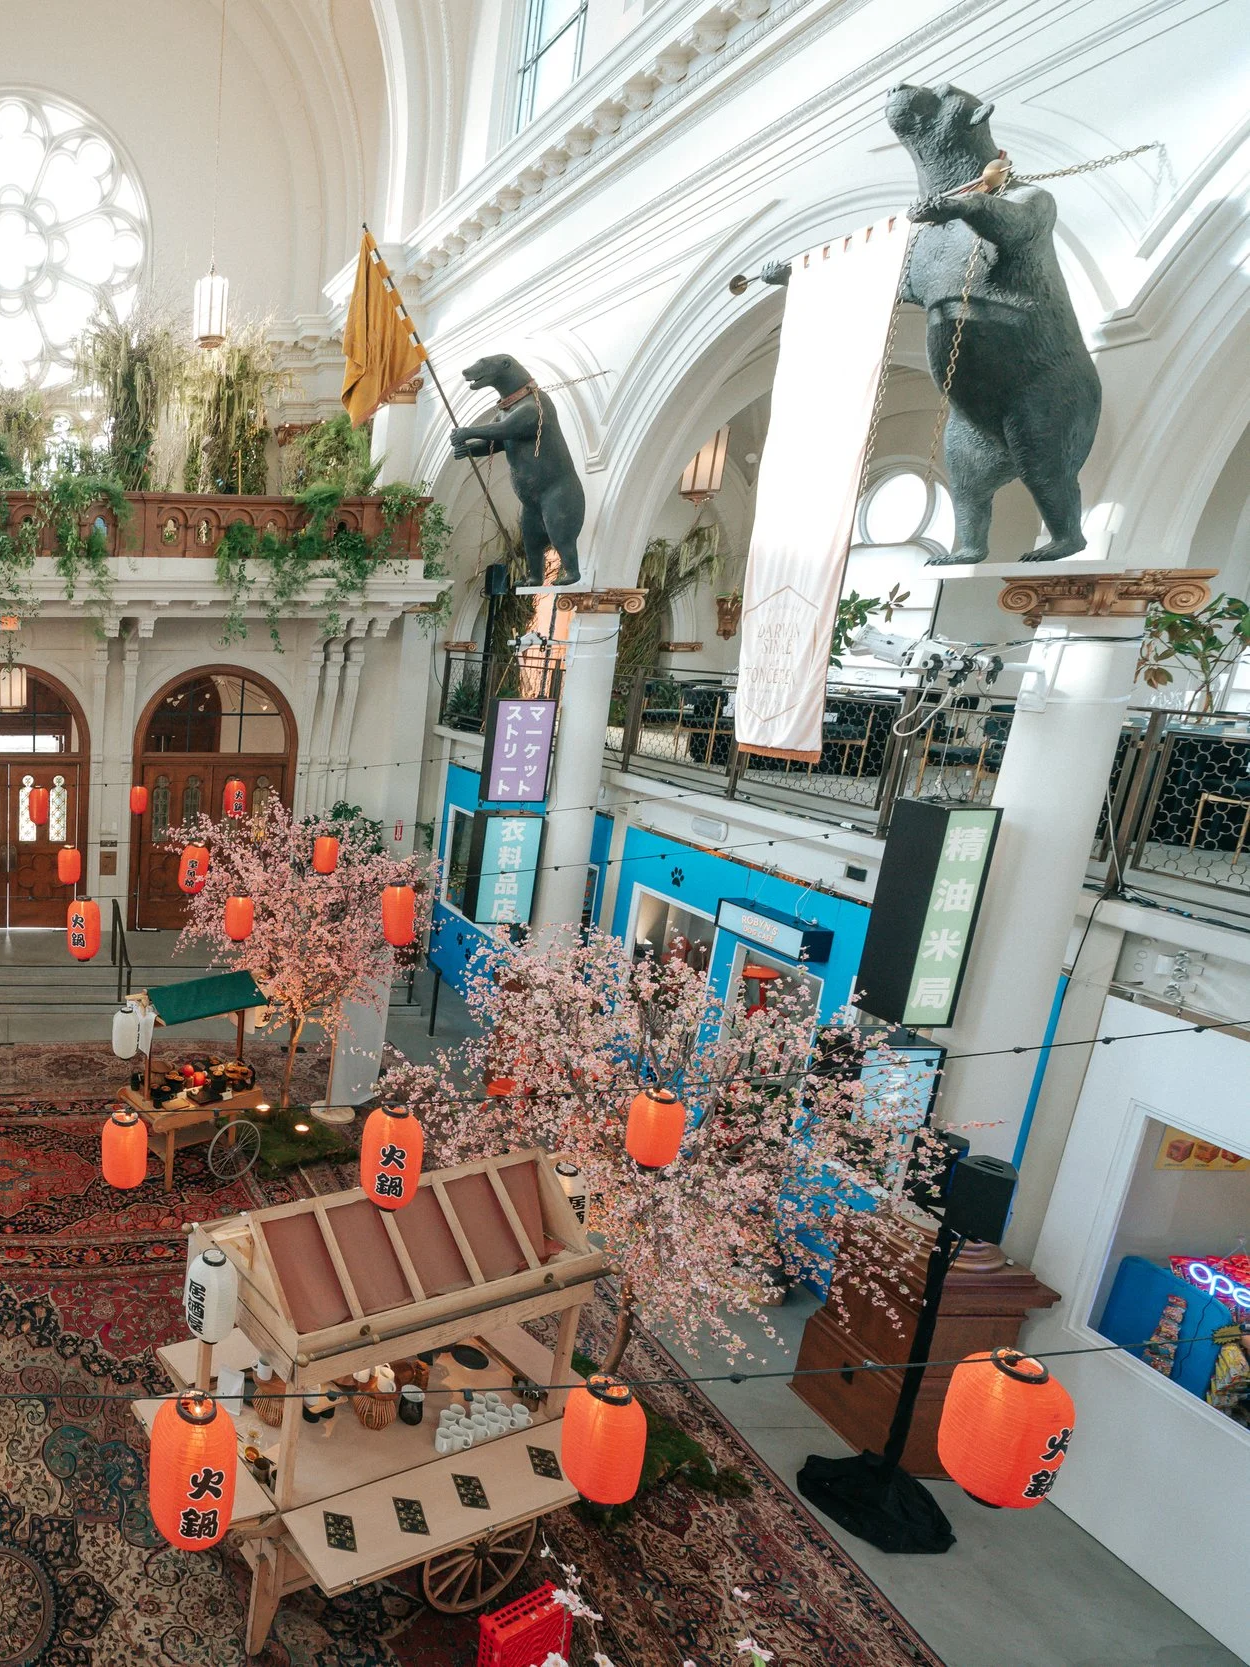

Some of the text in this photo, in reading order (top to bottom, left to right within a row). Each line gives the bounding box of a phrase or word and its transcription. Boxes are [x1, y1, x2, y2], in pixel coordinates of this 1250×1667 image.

[497, 706, 522, 796] ストリート
[517, 706, 546, 796] マーケット
[489, 820, 526, 922] 衣料品店
[71, 913, 86, 948] 火鍋
[741, 914, 780, 936] ROBYN'S
[910, 826, 988, 1009] 精油米局
[376, 1144, 406, 1198] 火鍋
[179, 1467, 225, 1539] 火鍋
